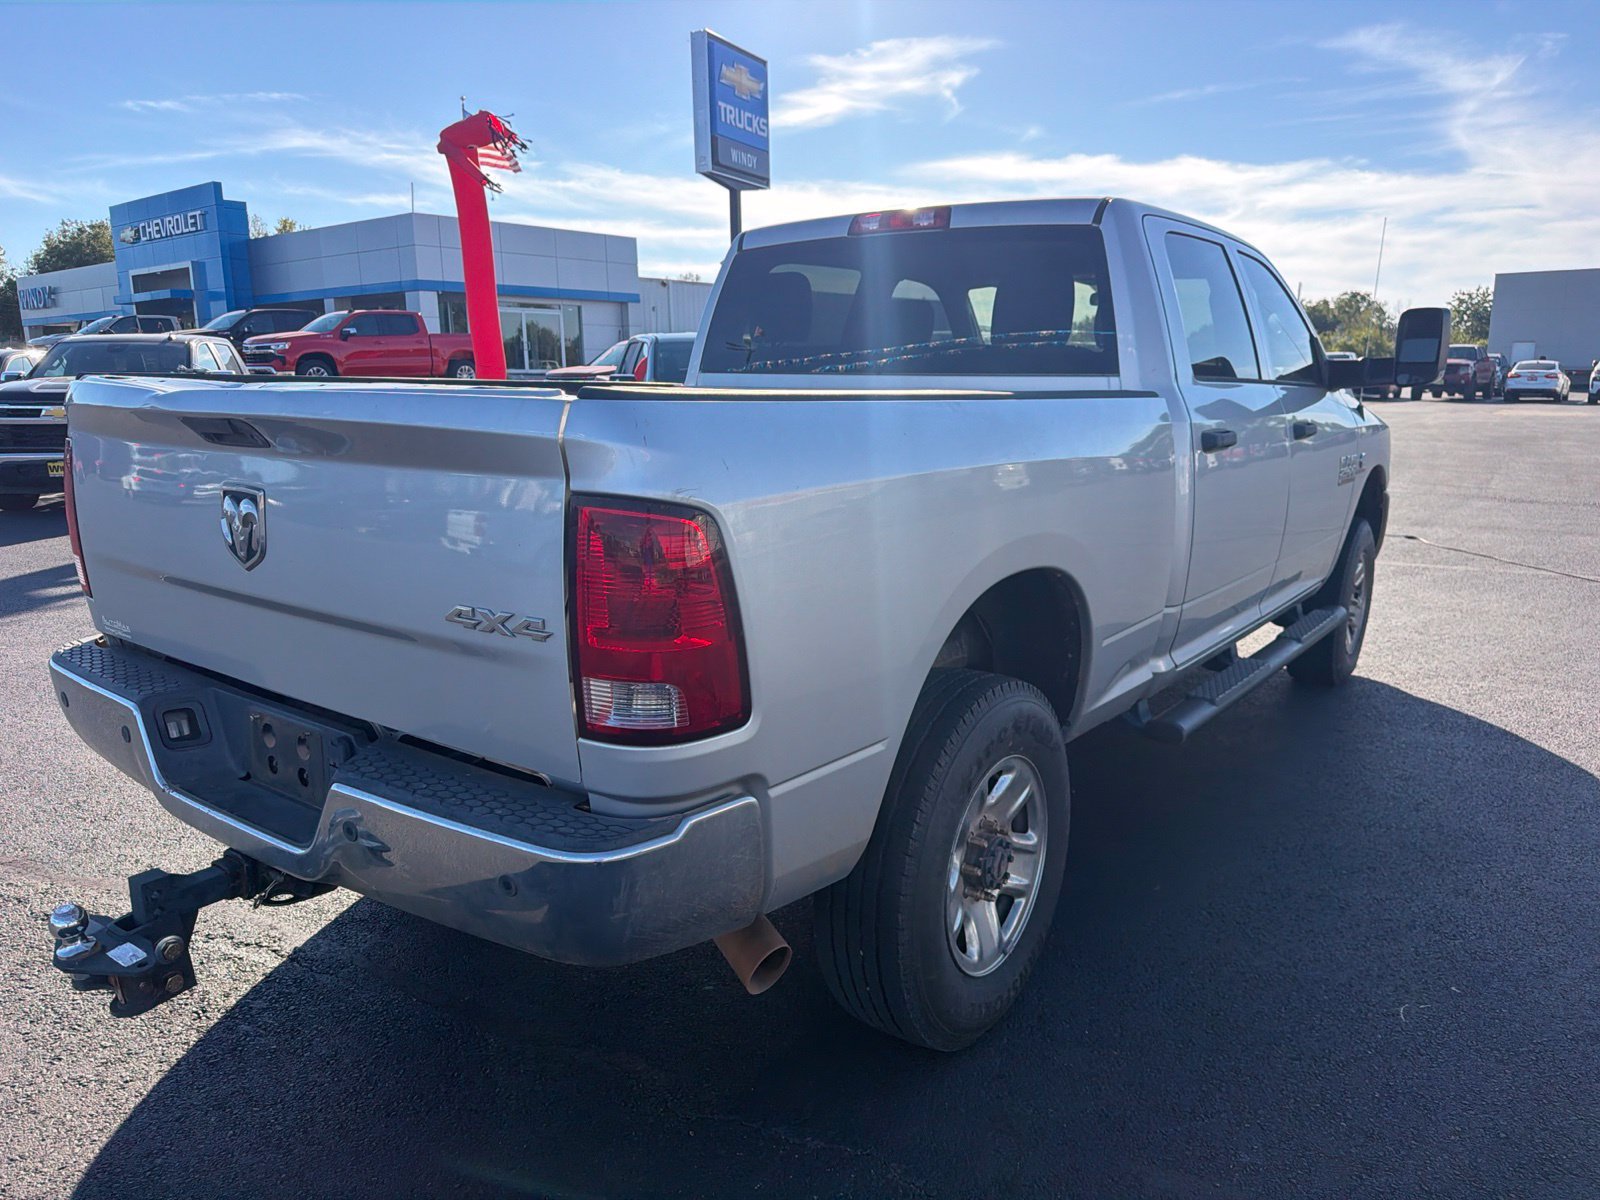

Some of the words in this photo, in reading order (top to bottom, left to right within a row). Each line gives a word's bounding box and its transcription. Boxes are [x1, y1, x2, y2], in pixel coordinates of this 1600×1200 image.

[718, 101, 768, 138] TRUCKS
[730, 148, 758, 169] WINDY
[139, 210, 203, 242] CHEVROLET
